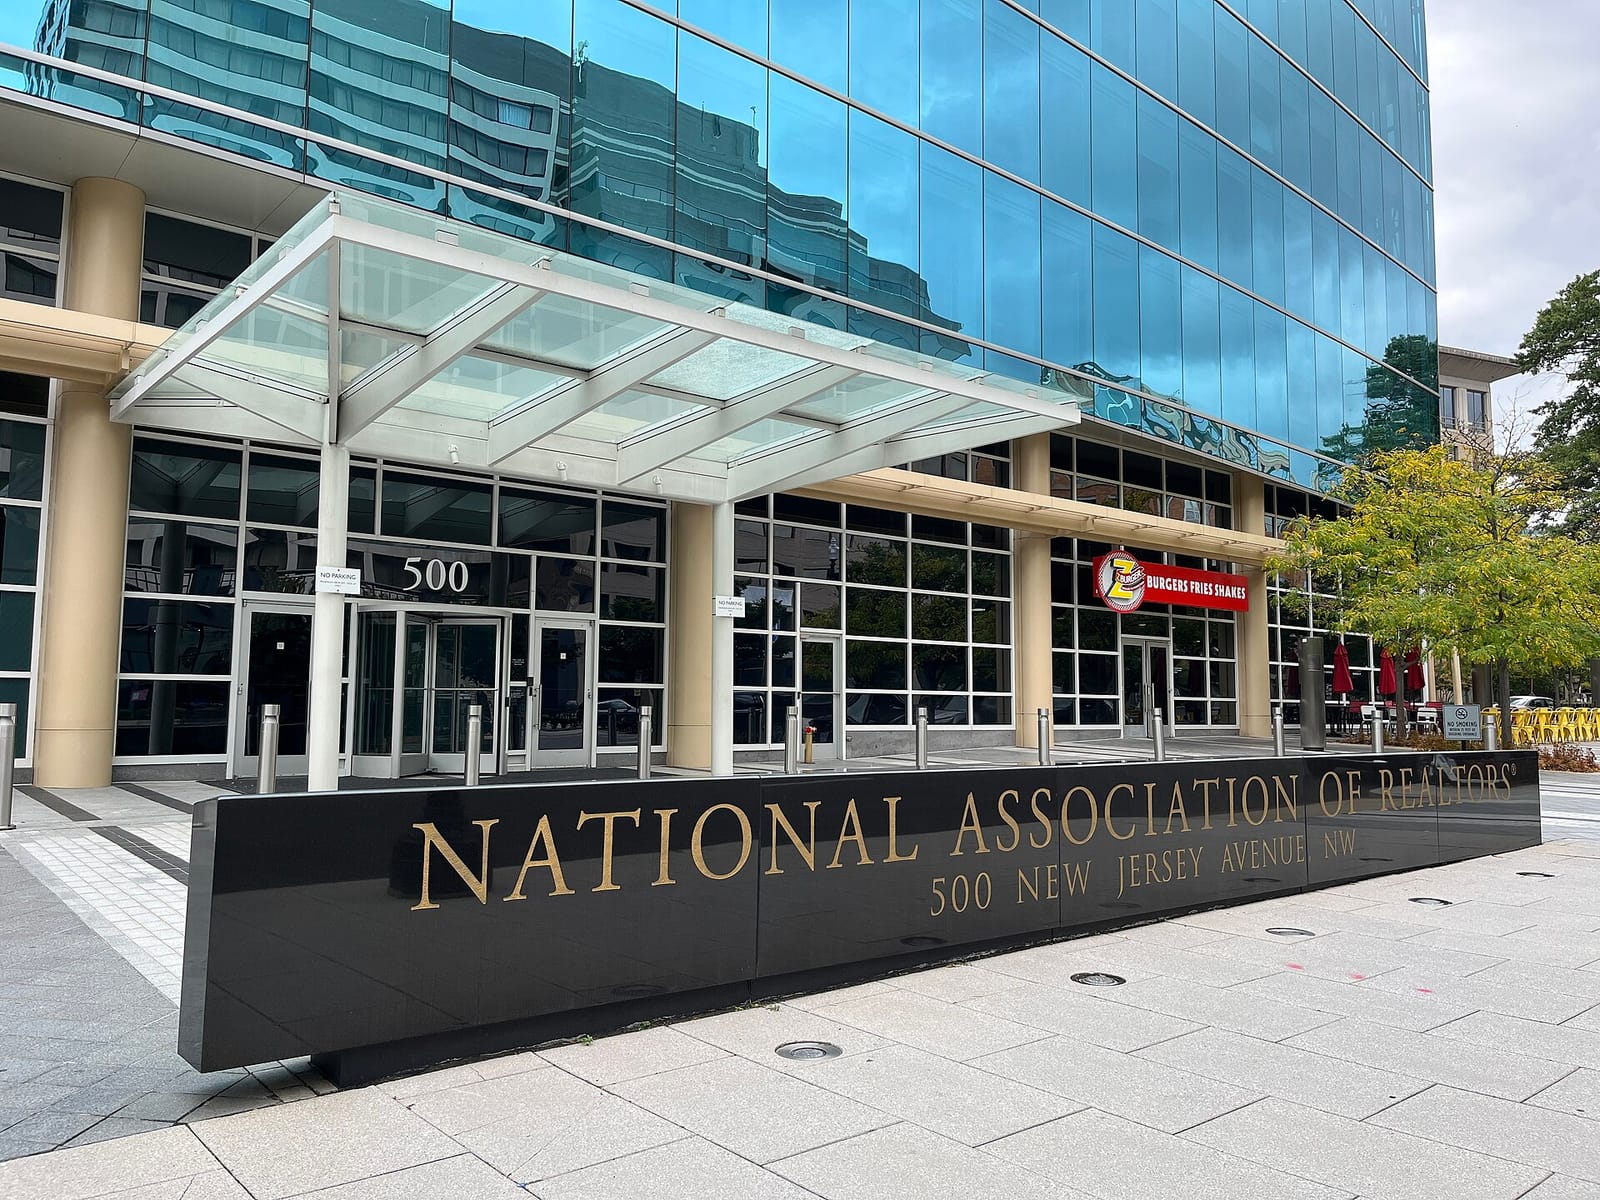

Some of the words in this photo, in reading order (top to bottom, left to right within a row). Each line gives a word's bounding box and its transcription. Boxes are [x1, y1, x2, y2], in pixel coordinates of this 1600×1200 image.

[403, 557, 468, 592] 500
[1147, 575, 1188, 593] BURGERS
[1190, 581, 1213, 595] FRIES
[1214, 584, 1246, 599] SHAKES
[410, 796, 919, 910] NATIONAL
[950, 774, 1299, 857] ASSOCIATION
[1319, 771, 1361, 817] OF
[930, 872, 993, 917] 500
[1017, 860, 1092, 904] NEW
[1117, 846, 1204, 899] JERSEY
[1324, 829, 1356, 859] NW
